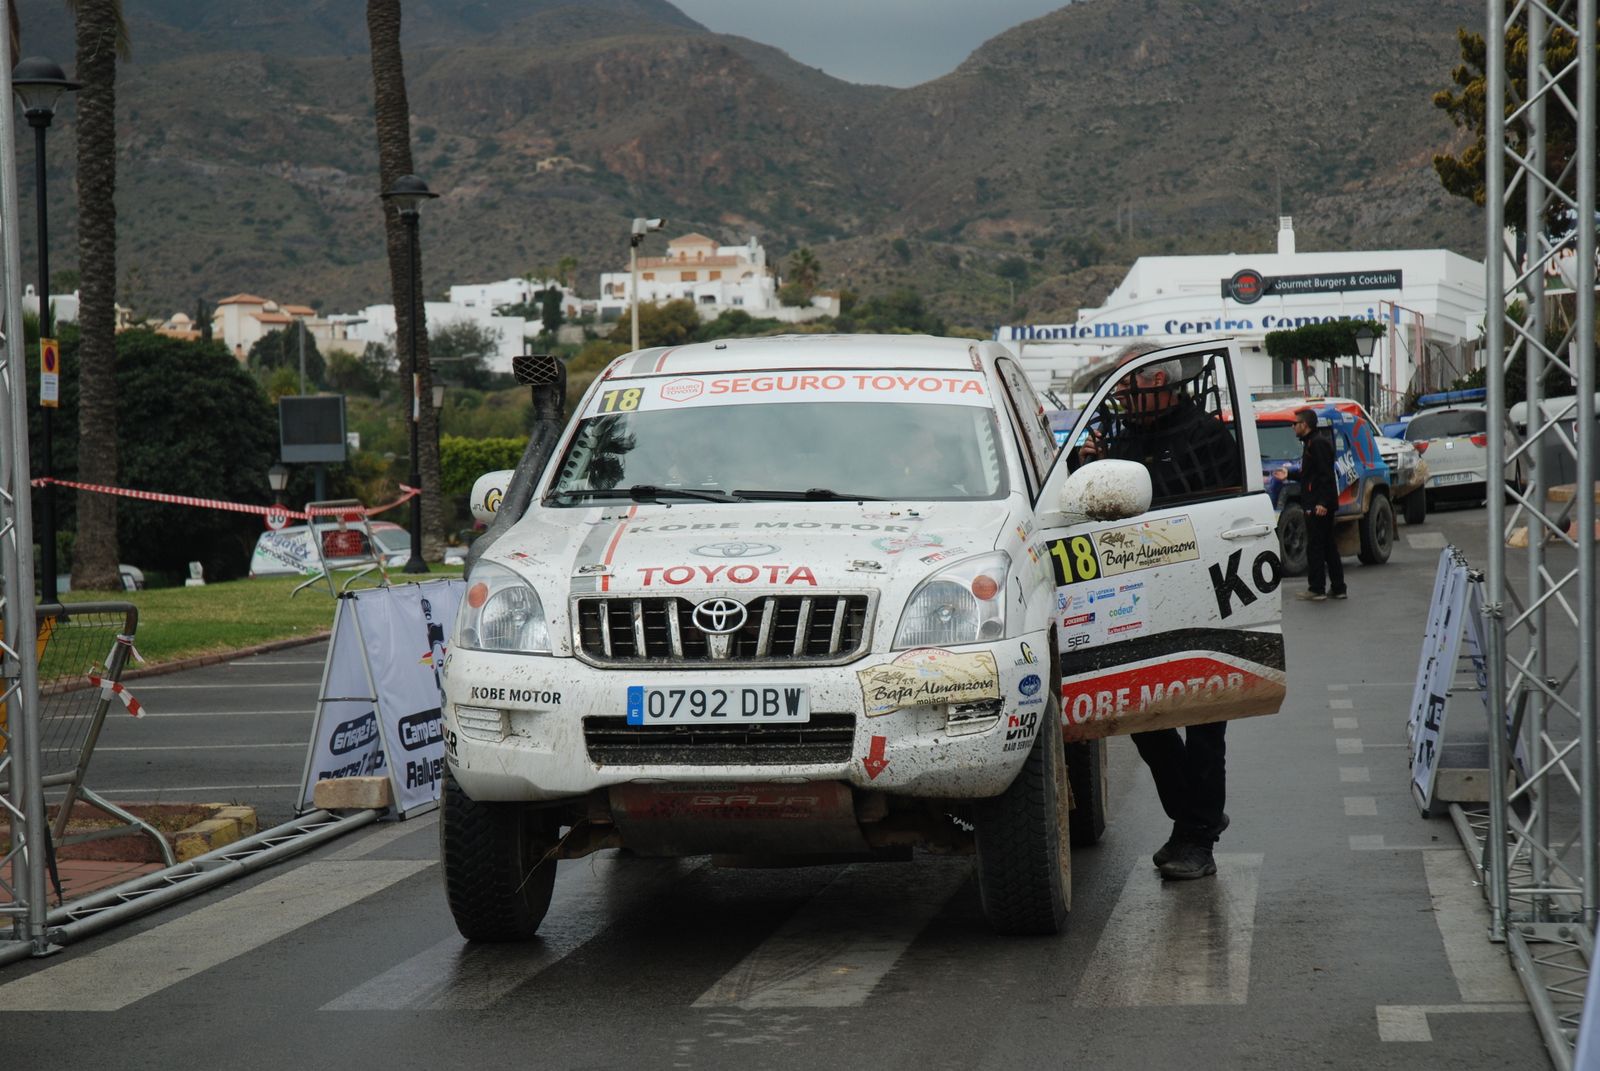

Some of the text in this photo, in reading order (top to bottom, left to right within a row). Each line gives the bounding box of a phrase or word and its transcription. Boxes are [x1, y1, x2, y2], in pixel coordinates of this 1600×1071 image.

[1275, 279, 1312, 290] Gourmet
[1314, 277, 1347, 290] Burgers
[1350, 276, 1357, 286] &
[1359, 274, 1397, 286] Cocktails
[1165, 316, 1254, 335] Centro
[709, 375, 985, 395] SEGURO TOYOTA
[603, 387, 641, 413] 18
[629, 521, 910, 533] KOBE MOTOR
[1051, 536, 1097, 583] 18
[1101, 541, 1196, 569] Baja Almanzora
[637, 565, 818, 586] TOYOTA
[1068, 634, 1090, 647] SER
[471, 686, 561, 704] KOBE MOTOR
[869, 680, 993, 703] Baja Almanzora
[631, 709, 638, 717] E
[648, 688, 801, 718] 0792 DBW
[1061, 688, 1130, 726] KOBE
